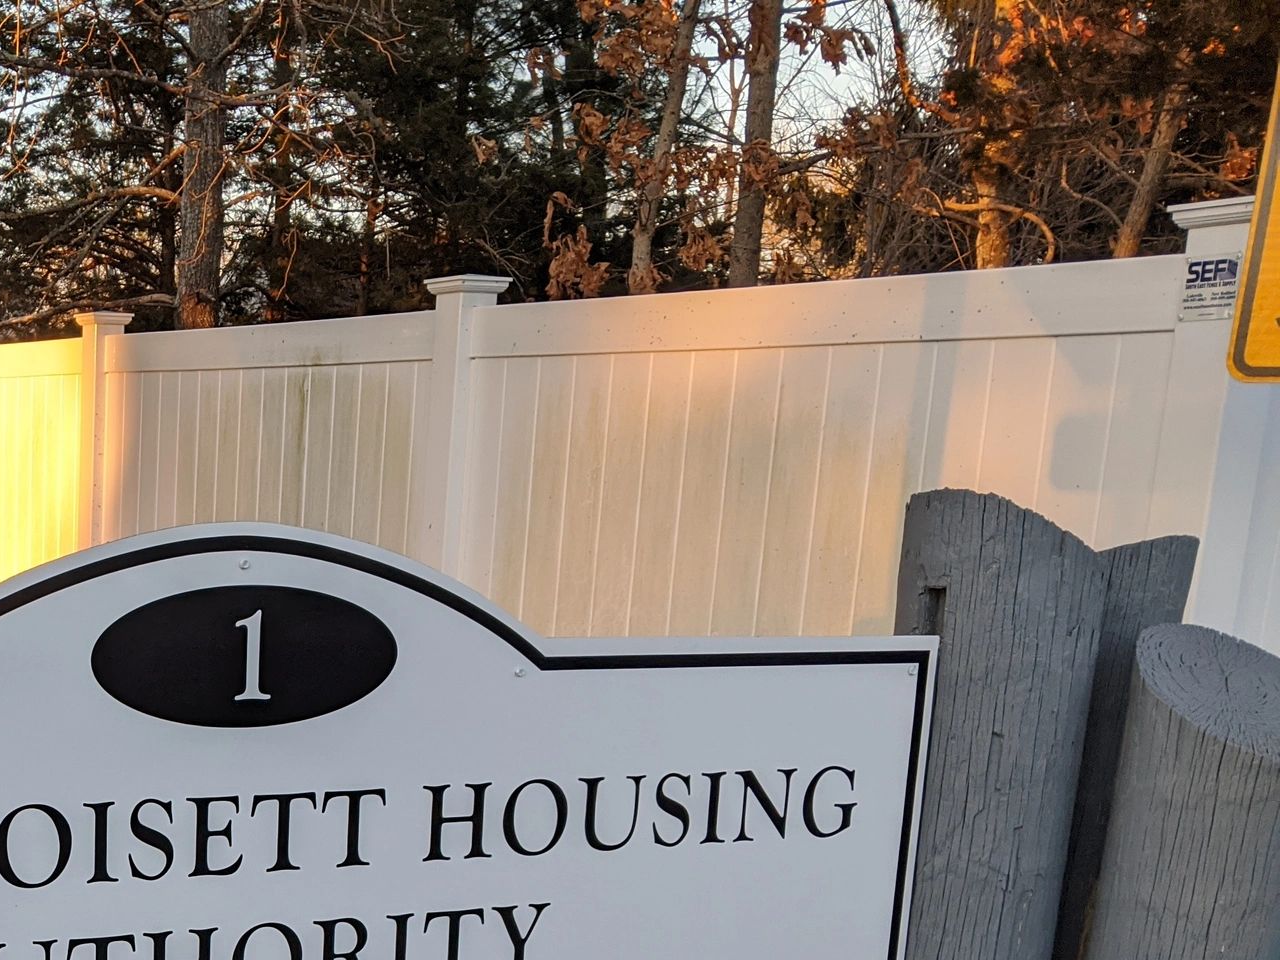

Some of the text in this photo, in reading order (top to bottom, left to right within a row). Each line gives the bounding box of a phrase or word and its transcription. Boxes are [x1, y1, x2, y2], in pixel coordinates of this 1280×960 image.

[1186, 259, 1228, 283] SEF
[234, 608, 272, 702] 1
[422, 765, 858, 863] HOUSING
